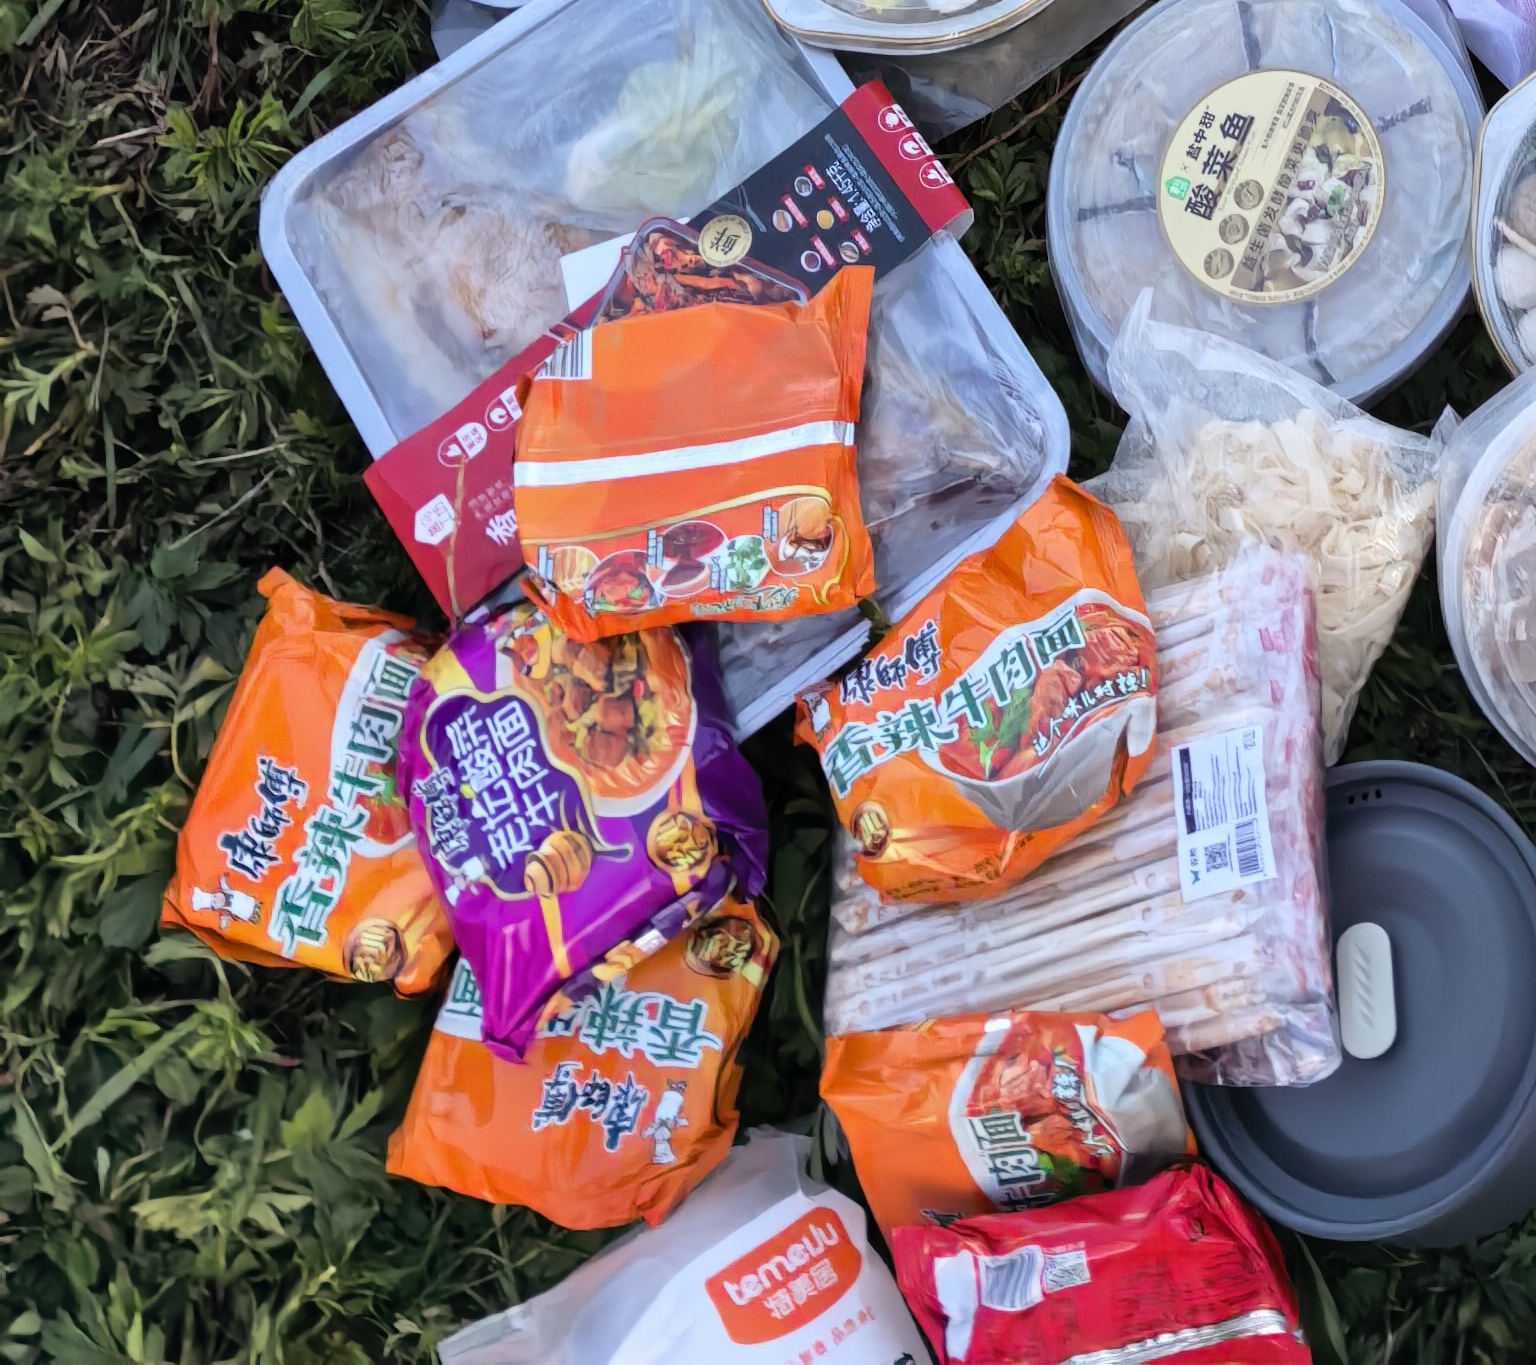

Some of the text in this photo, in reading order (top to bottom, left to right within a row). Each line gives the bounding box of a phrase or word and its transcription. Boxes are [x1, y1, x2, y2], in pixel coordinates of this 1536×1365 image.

[1184, 111, 1257, 222] 酸菜鱼
[1186, 106, 1216, 161] 盐中甜
[490, 697, 562, 829] 牛肉面
[824, 602, 1085, 797] 香辣牛肉面
[268, 646, 421, 959] 香辣牛肉面
[444, 702, 534, 872] 老坛酸菜
